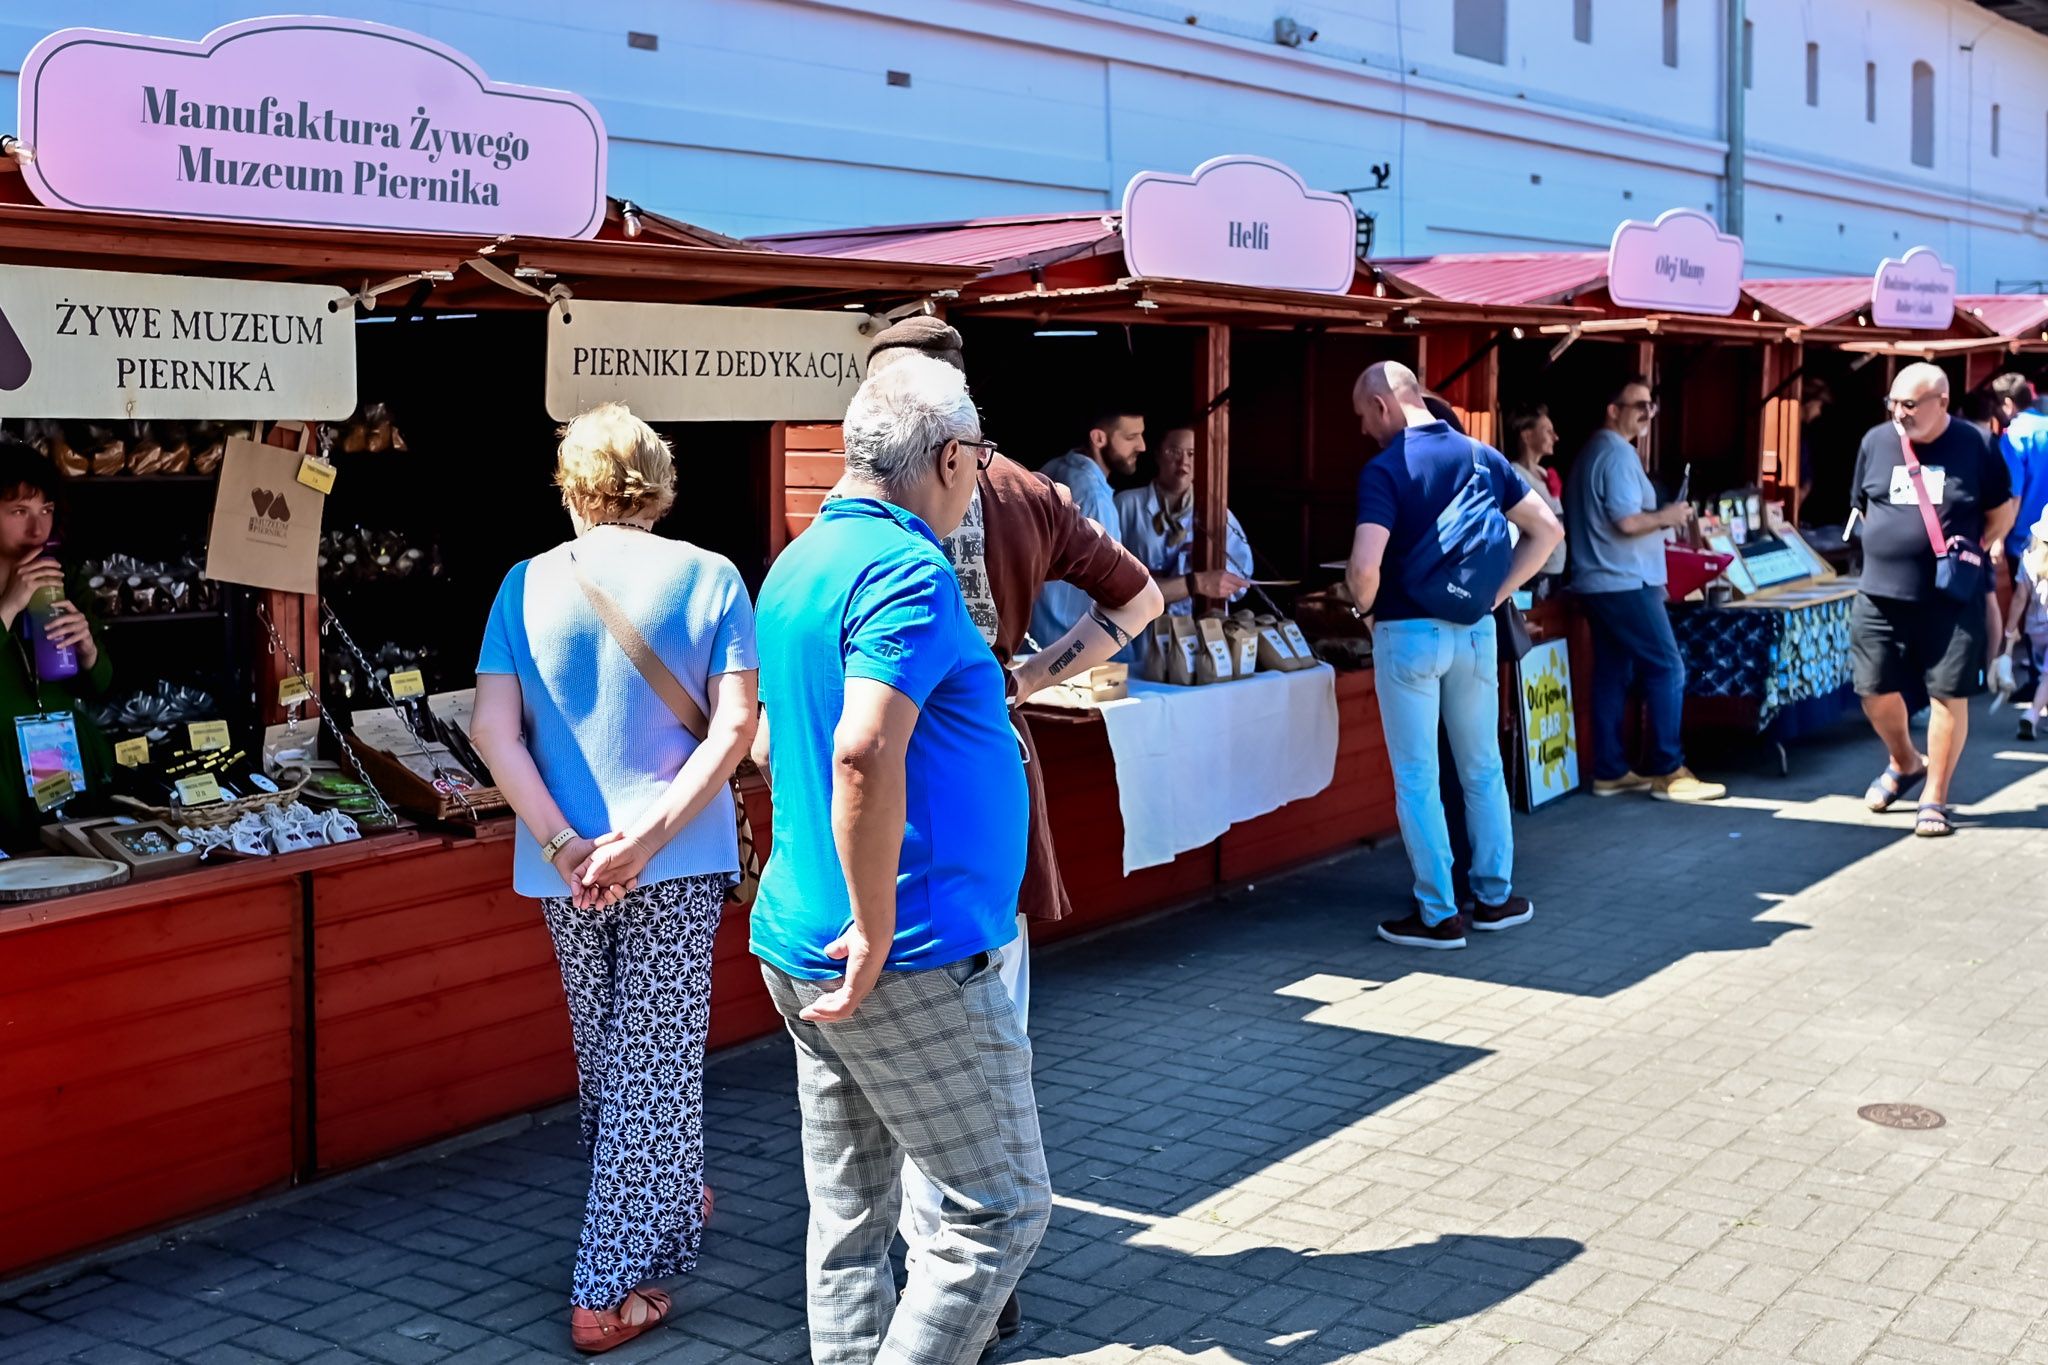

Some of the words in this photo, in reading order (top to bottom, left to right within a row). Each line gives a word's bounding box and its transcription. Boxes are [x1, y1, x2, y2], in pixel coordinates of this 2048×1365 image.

[140, 85, 402, 151] Manufaktura
[409, 105, 530, 171] Żywego
[176, 144, 344, 195] Muzeum
[352, 160, 500, 207] Piernika
[1228, 220, 1269, 250] Helfi
[55, 297, 162, 340] ŻYWE
[170, 309, 324, 346] MUZEUM
[116, 357, 276, 393] PIERNIKA
[572, 346, 689, 378] PIERNIKI
[695, 348, 711, 378] Z
[716, 349, 862, 388] DEDYKACJĄ
[1540, 710, 1562, 741] BAR
